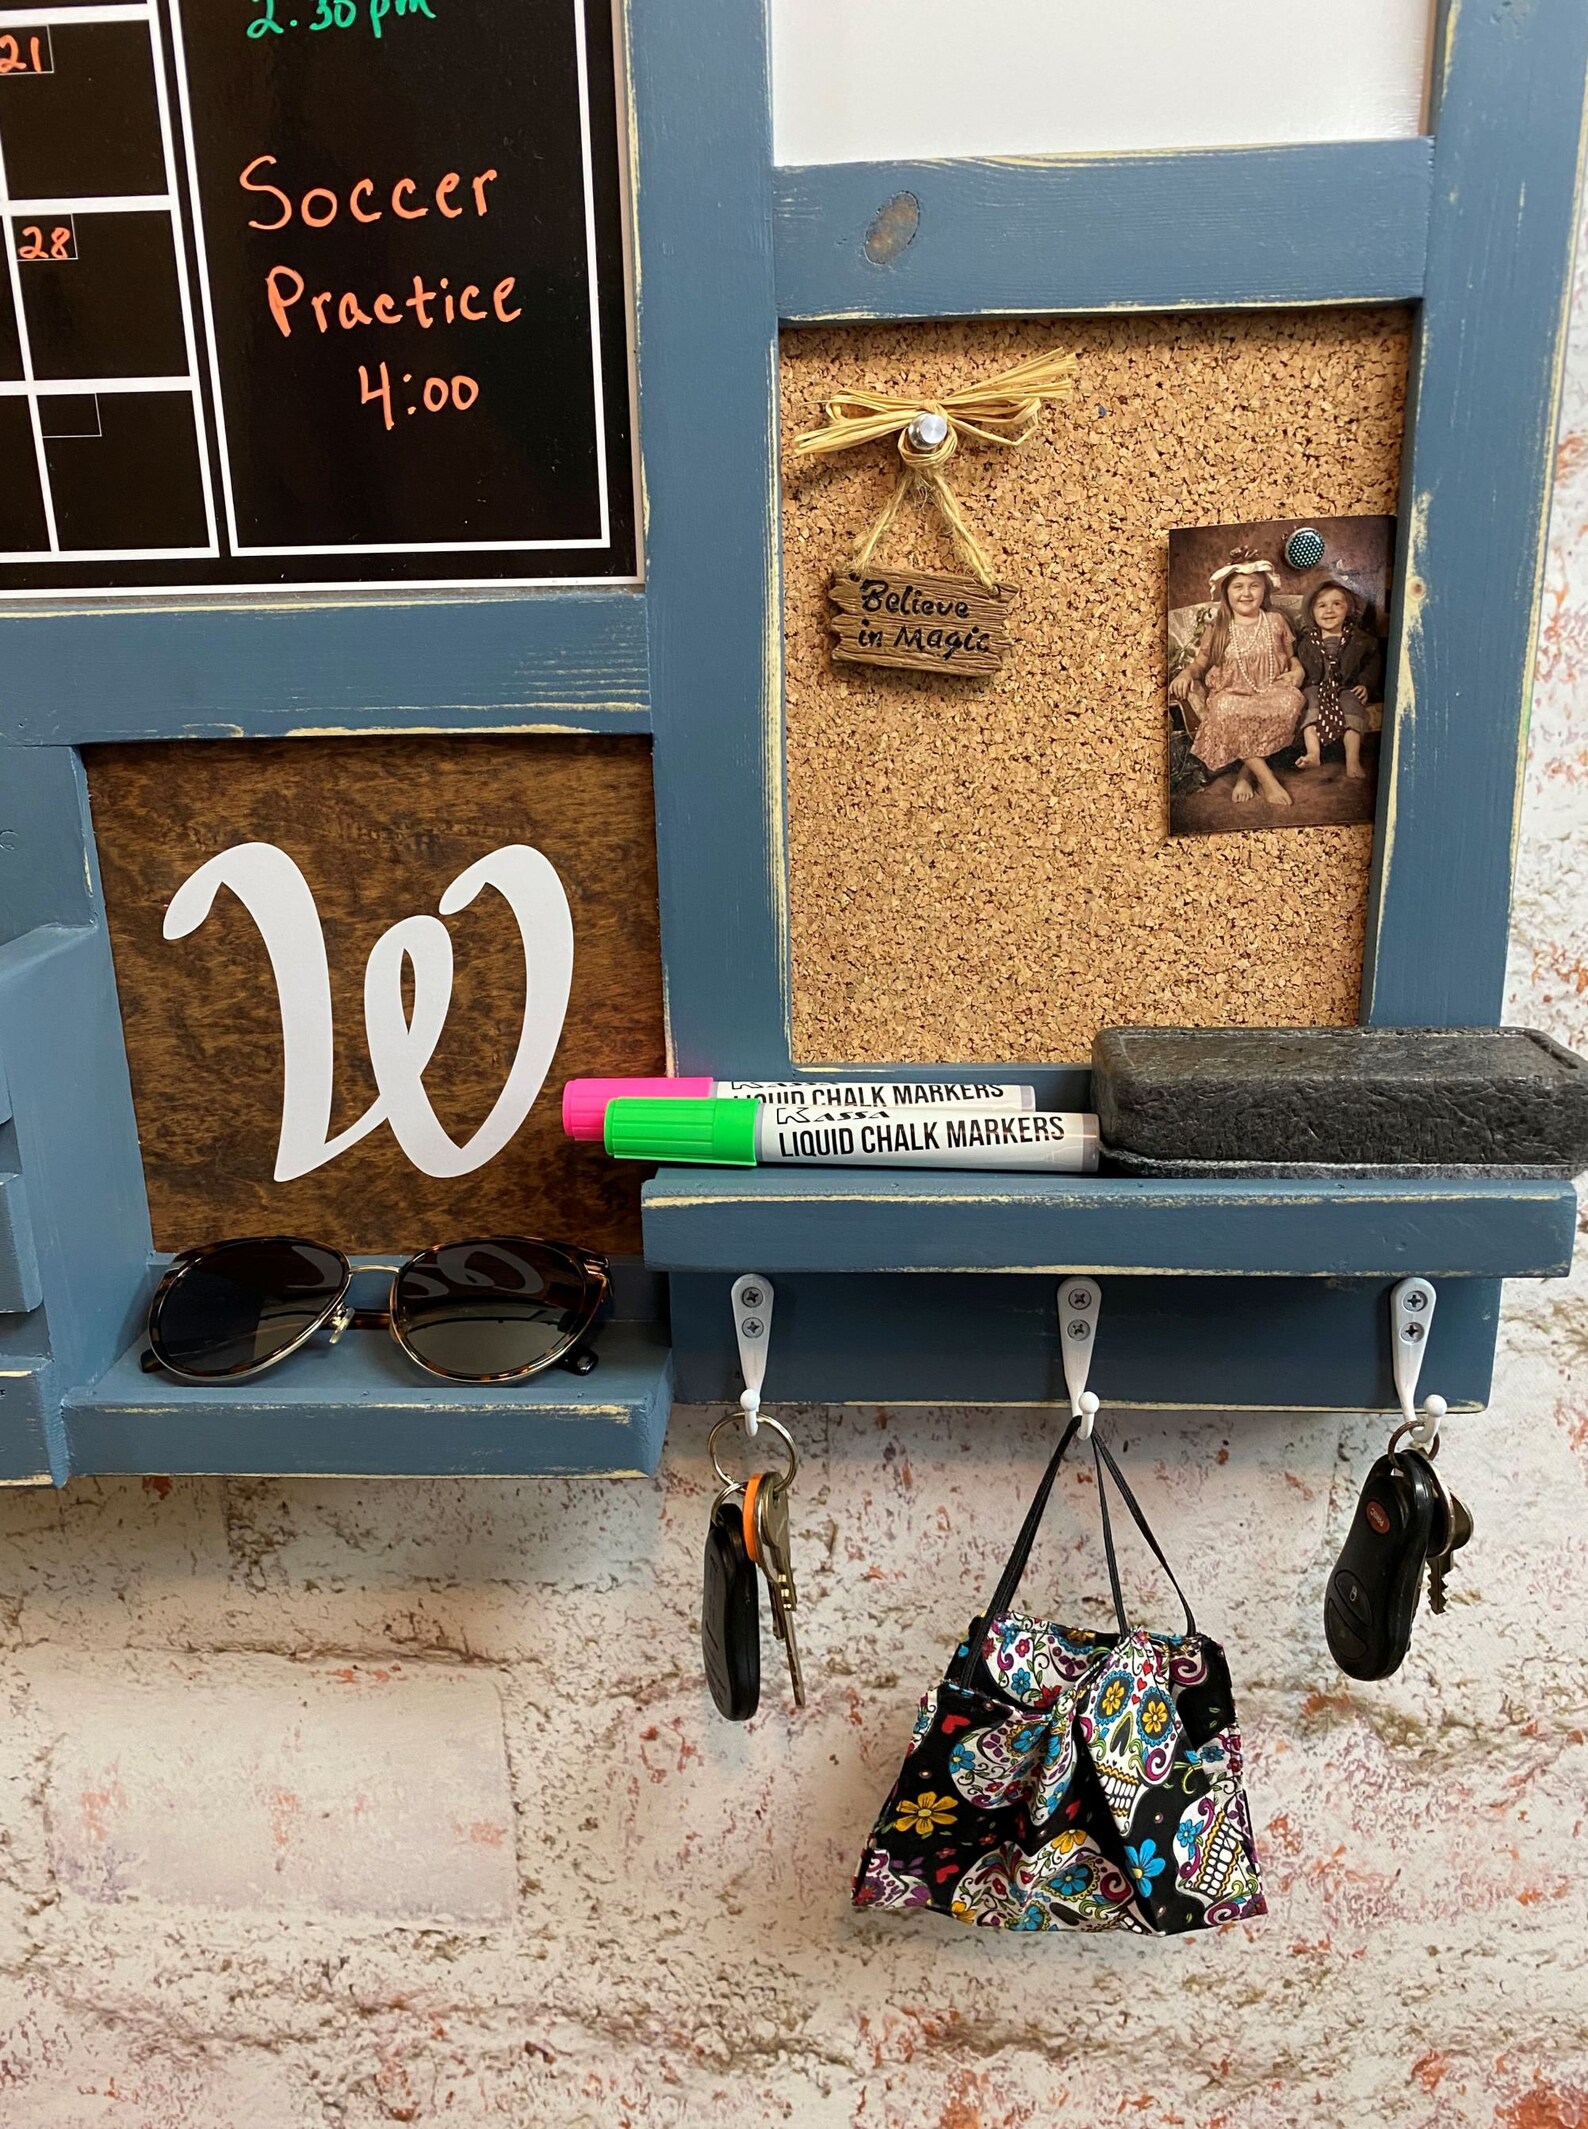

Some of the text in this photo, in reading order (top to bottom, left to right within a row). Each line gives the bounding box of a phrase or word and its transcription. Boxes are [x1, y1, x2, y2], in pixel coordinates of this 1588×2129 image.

[0, 34, 42, 73] 21
[239, 155, 498, 231] Soccer
[18, 226, 71, 259] 28
[265, 265, 522, 337] Practice
[358, 361, 480, 431] 4:00
[860, 578, 970, 618] Believe
[858, 618, 990, 661] in Magic
[163, 842, 575, 1182] W
[811, 1085, 888, 1107] CHALK
[892, 1084, 1004, 1105] MARKERS
[778, 1116, 1065, 1157] LIQUID CHALK MARKERS
